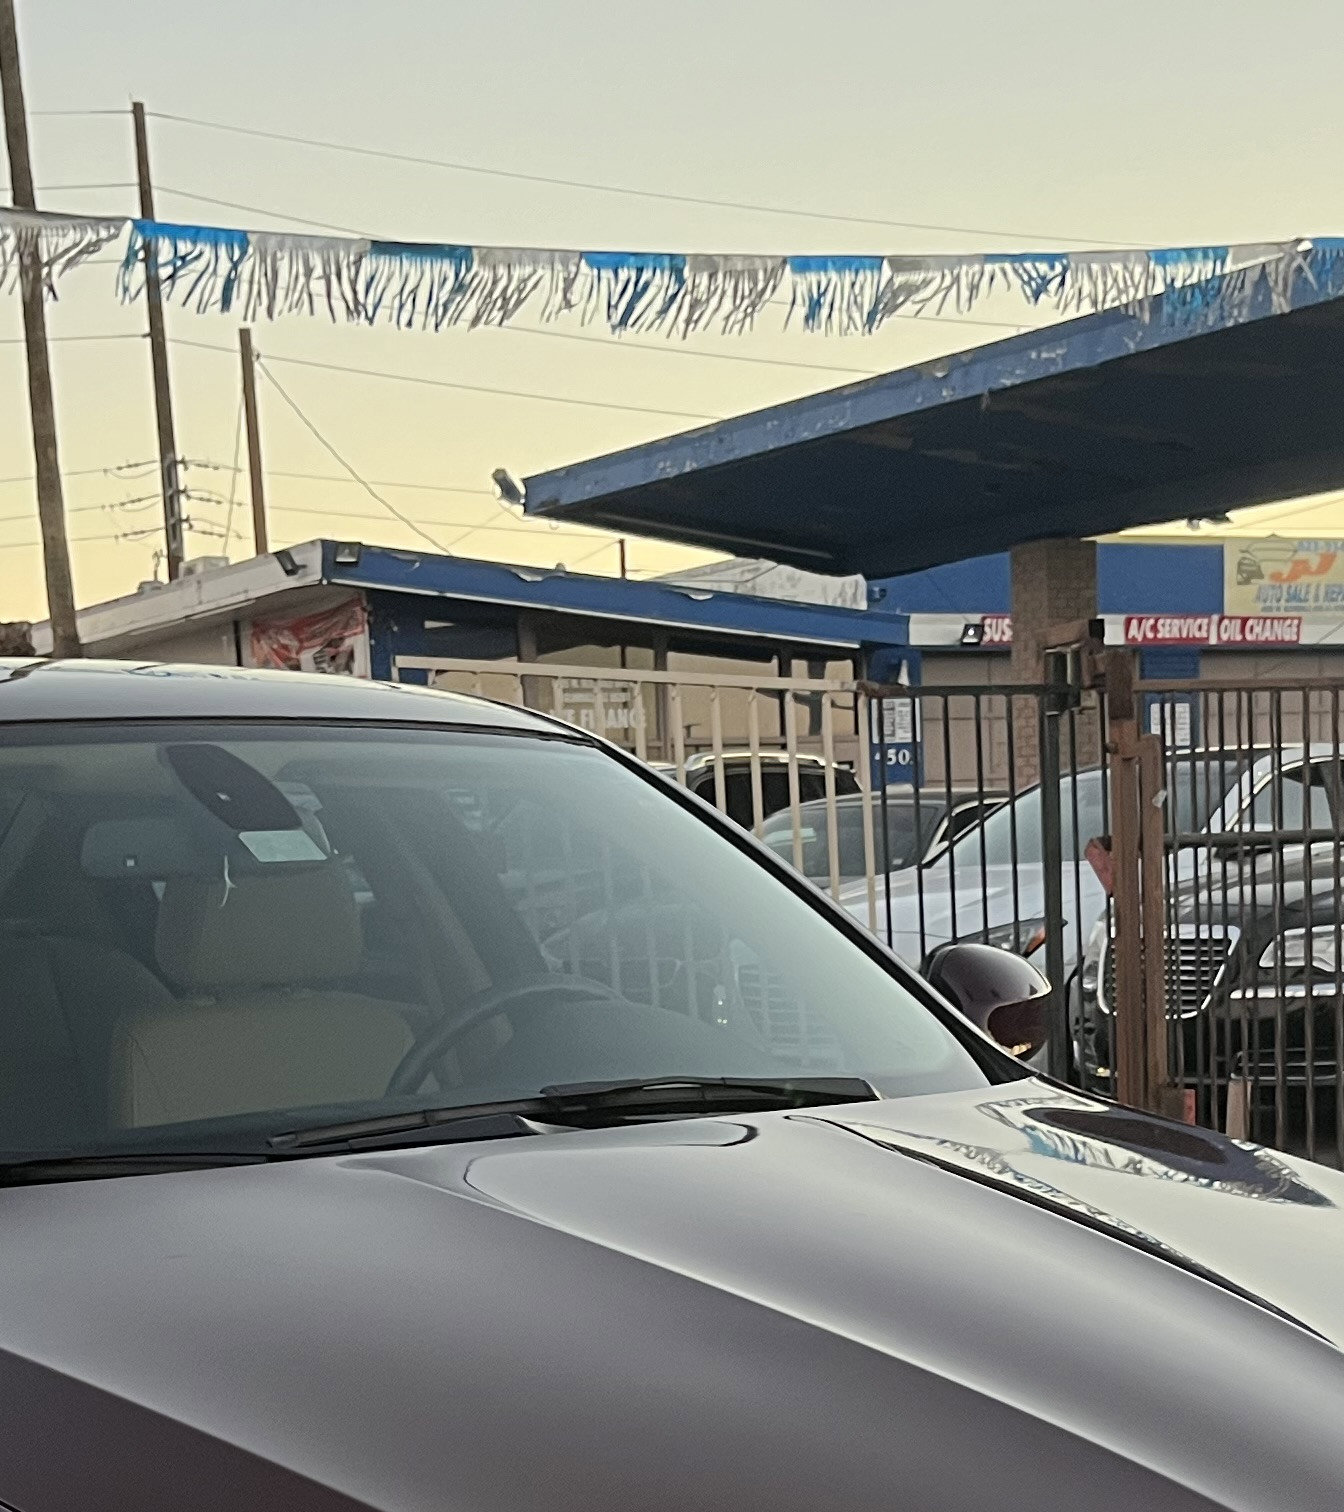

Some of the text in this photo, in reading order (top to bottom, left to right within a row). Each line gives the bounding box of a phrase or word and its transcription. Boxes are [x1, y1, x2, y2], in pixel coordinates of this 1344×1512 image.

[1253, 583, 1283, 603] AUTO
[1285, 583, 1310, 603] SALE
[1128, 618, 1209, 642] A/C SERVICE
[1220, 618, 1299, 641] OIL CHANGE
